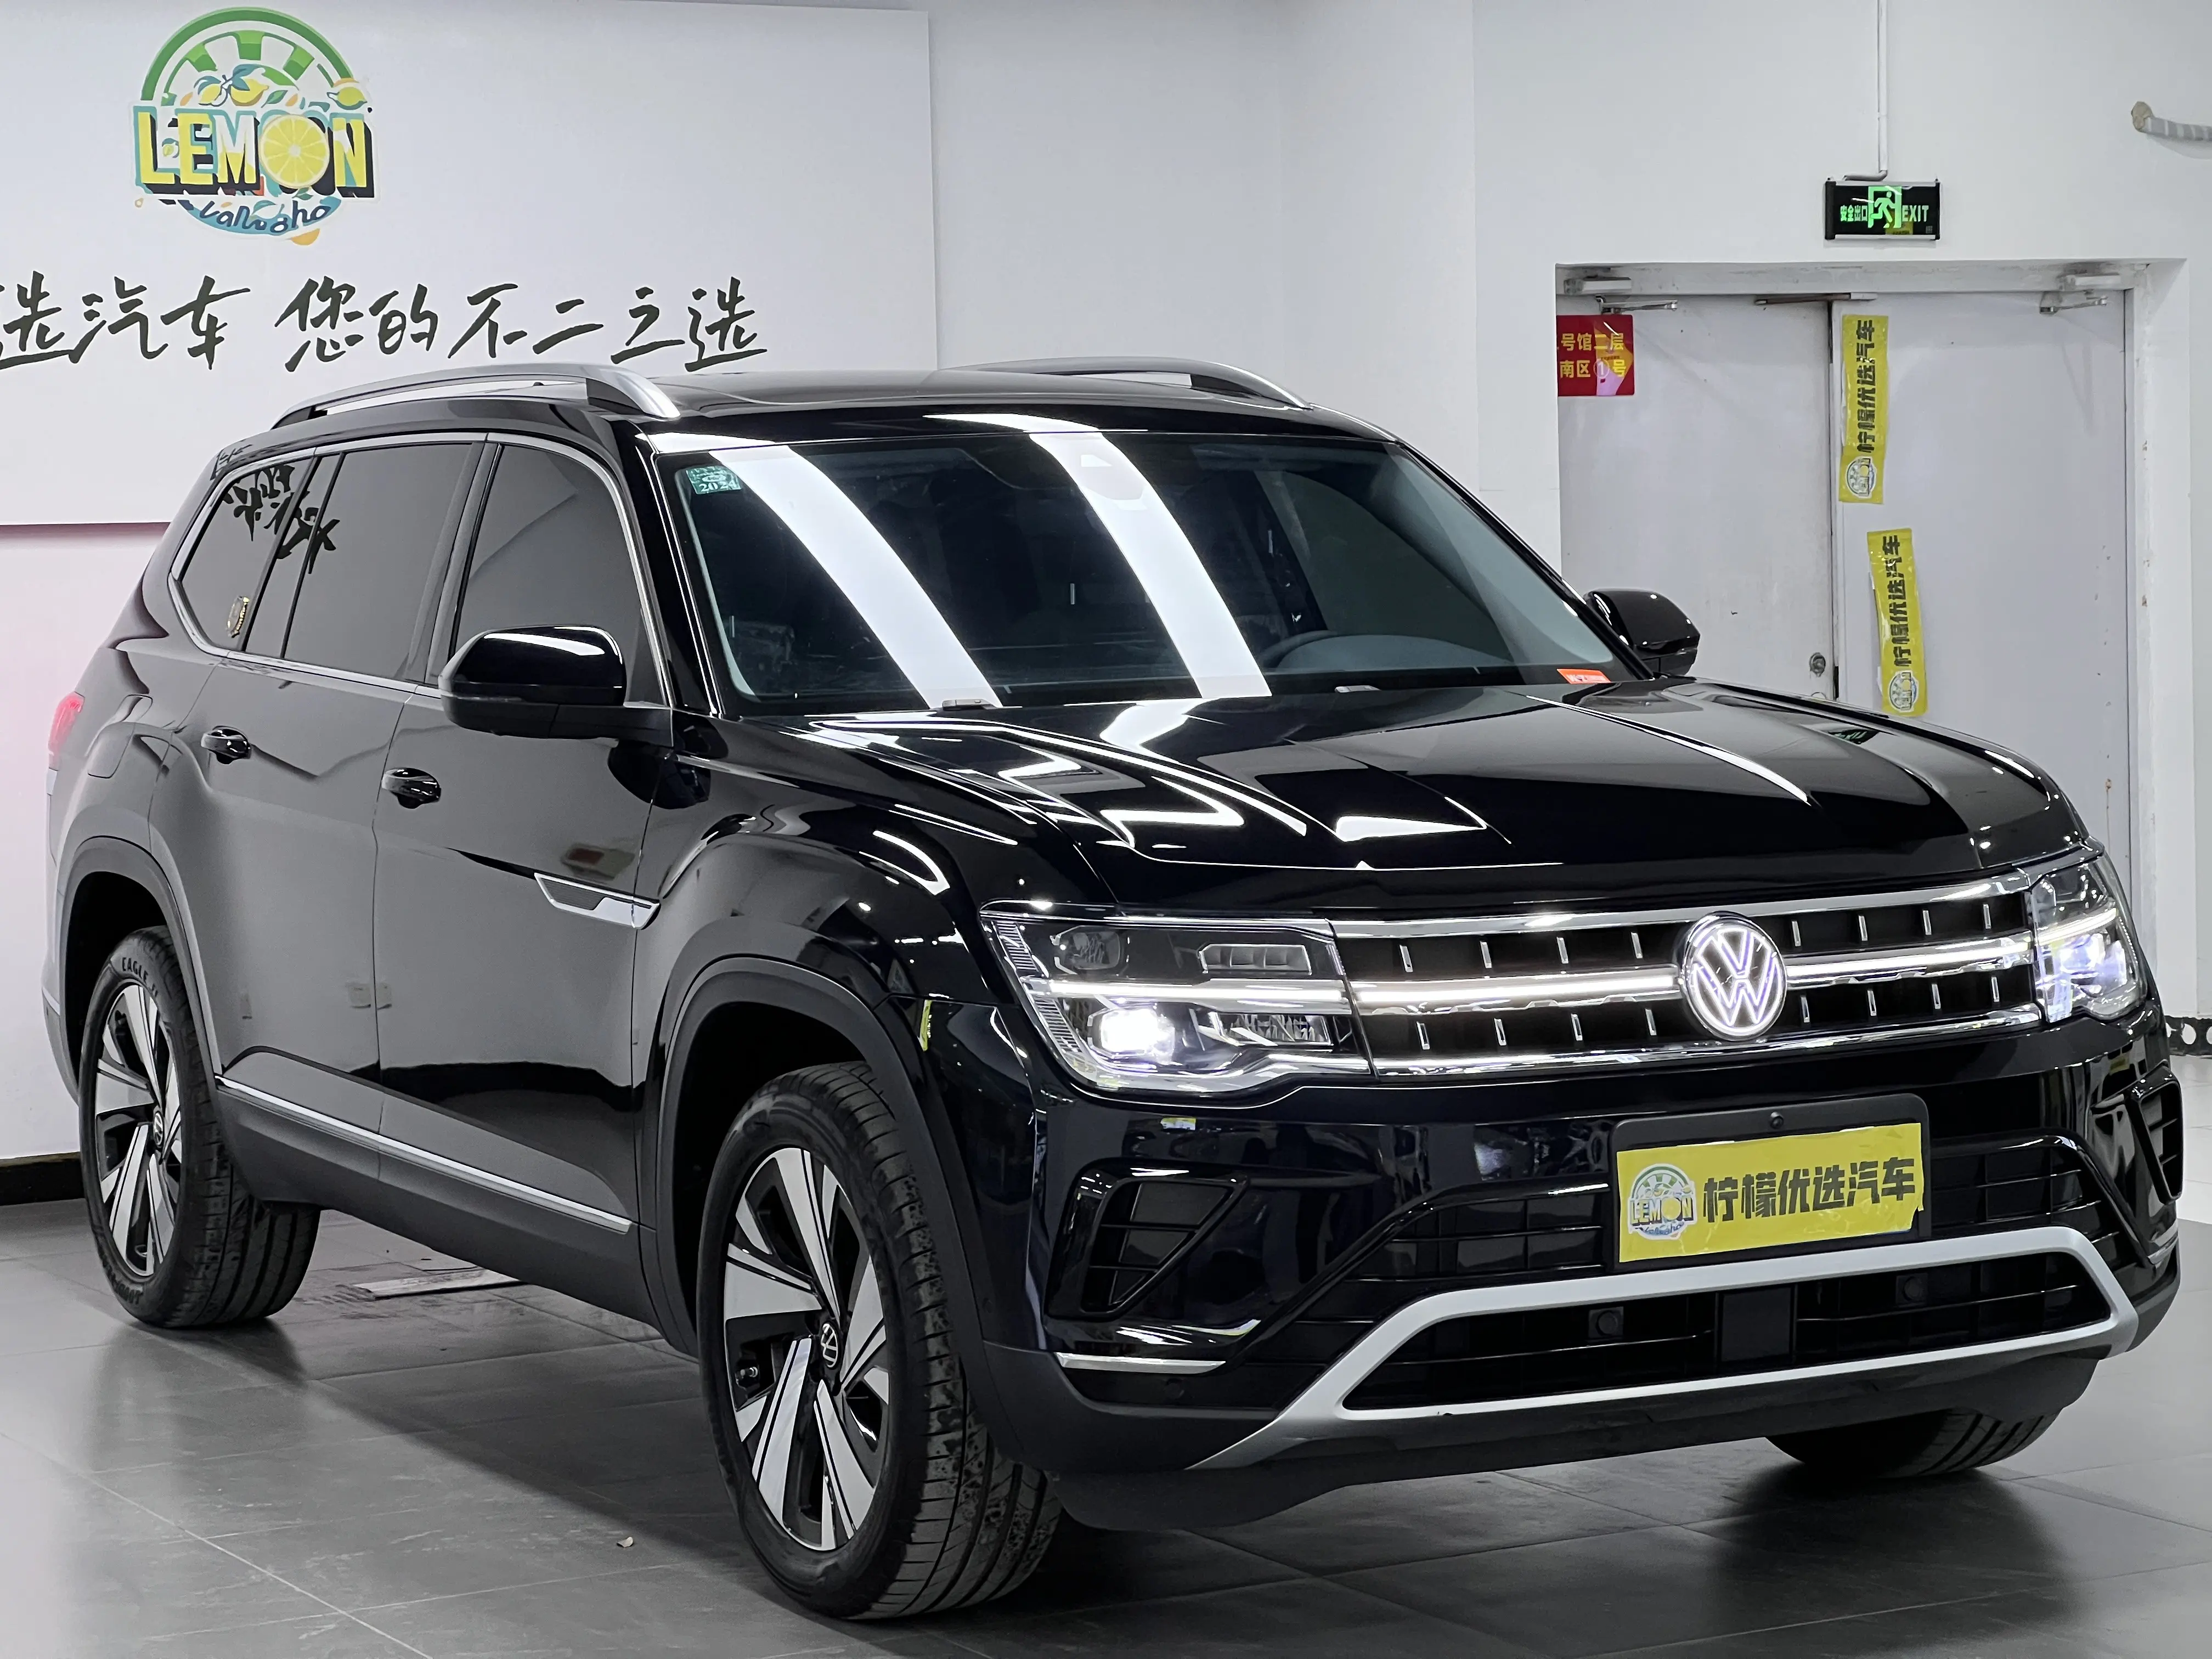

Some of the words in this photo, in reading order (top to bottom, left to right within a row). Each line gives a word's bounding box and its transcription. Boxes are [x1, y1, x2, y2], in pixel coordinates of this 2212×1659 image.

[134, 106, 374, 198] LEMON
[1840, 205, 1867, 222] 安全出口
[1902, 205, 1929, 222] EXIT
[275, 276, 768, 373] 您的不二之选
[1556, 332, 1624, 351] 号馆二层
[1857, 320, 1876, 453] 柠檬优选汽车
[1882, 535, 1912, 667] 柠檬优选汽车
[122, 957, 149, 985] EAGLE
[1703, 1157, 1915, 1223] 柠檬优选汽车
